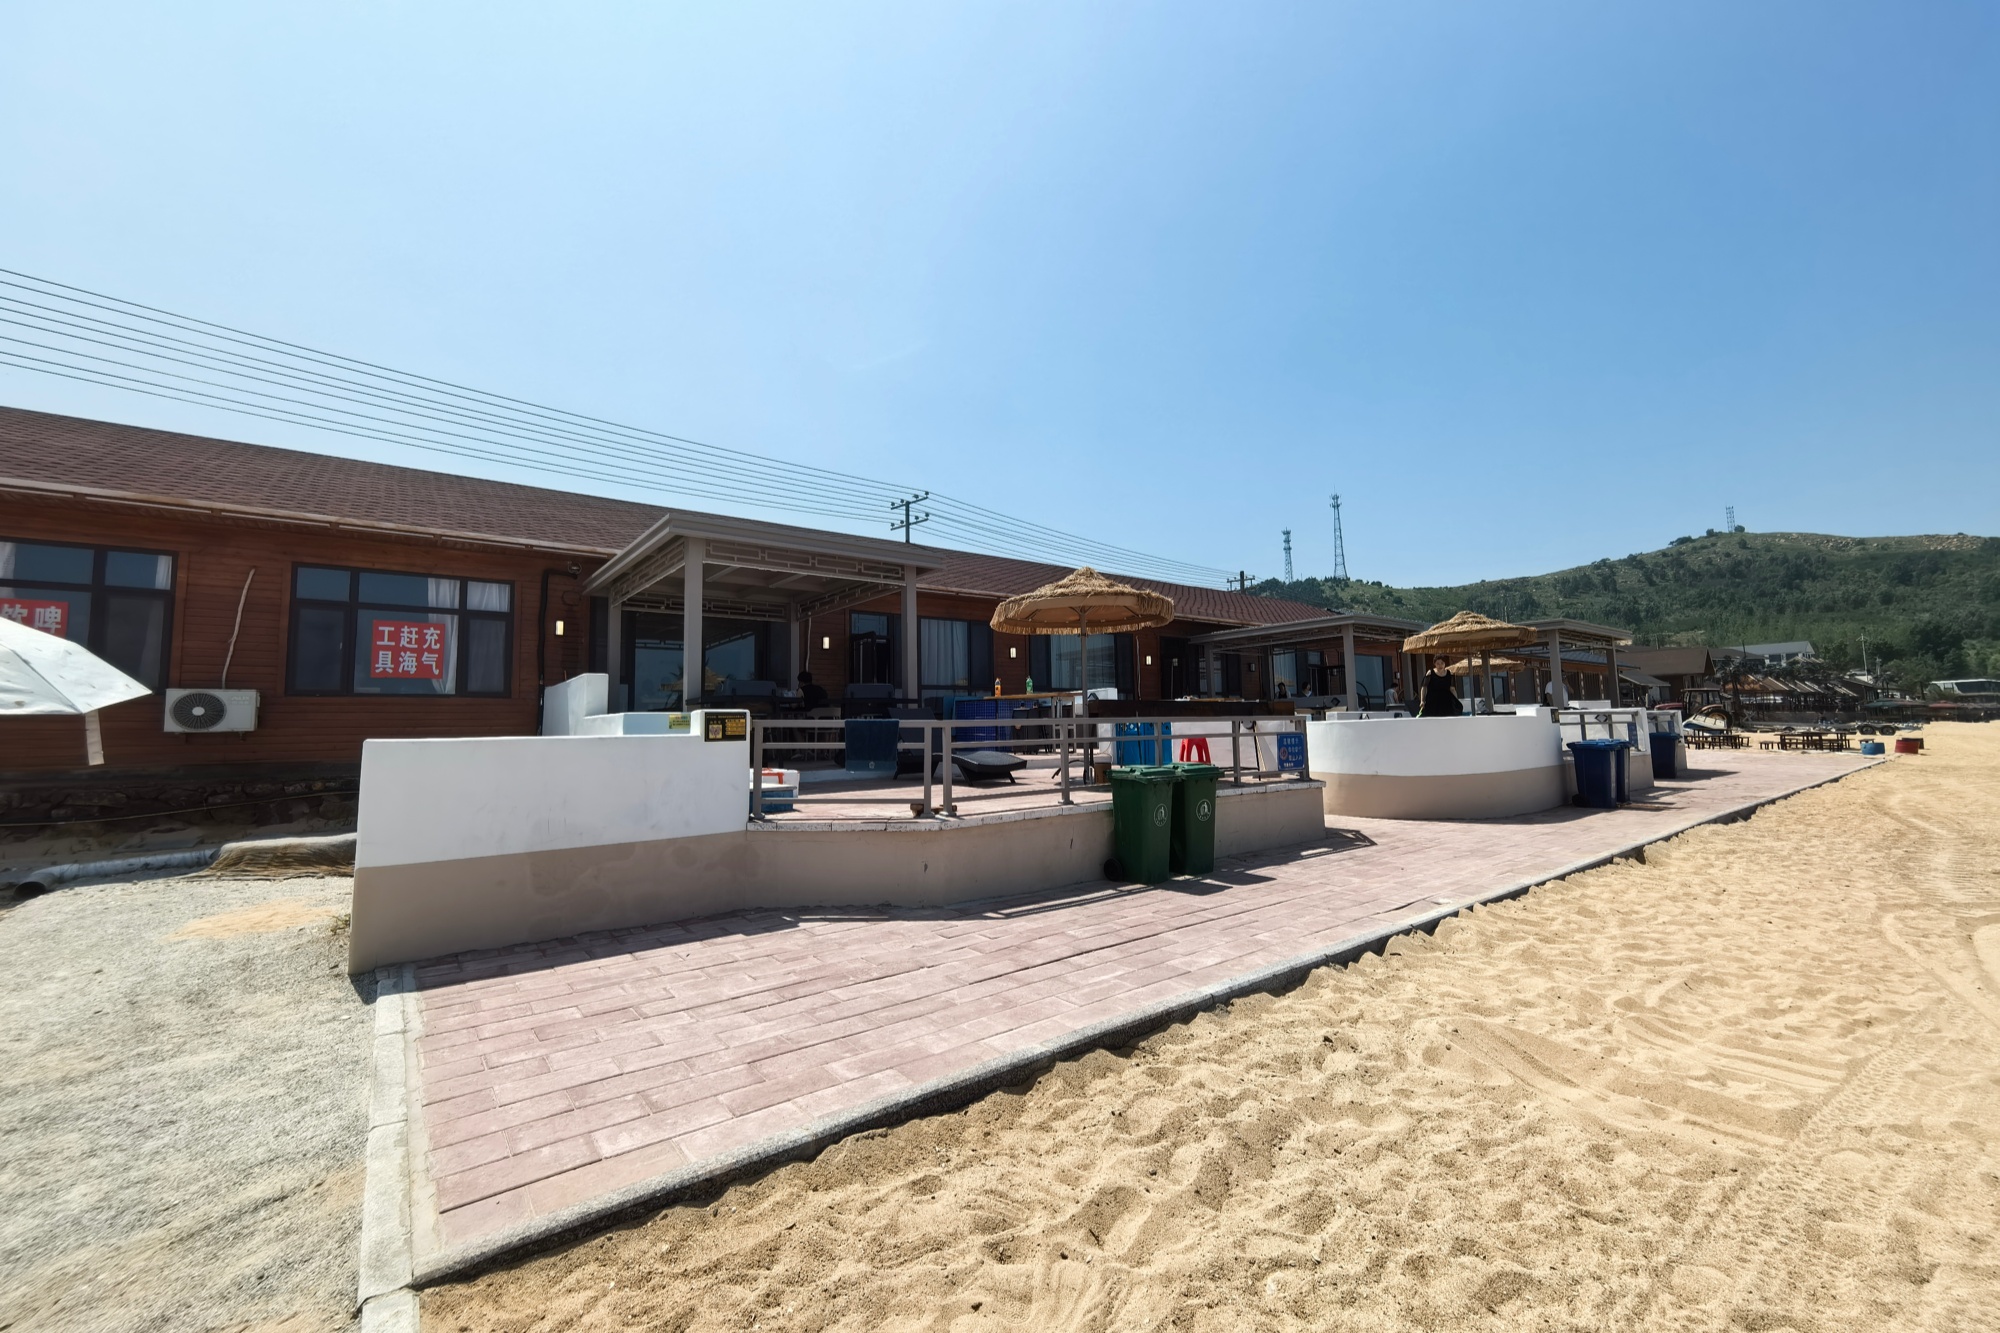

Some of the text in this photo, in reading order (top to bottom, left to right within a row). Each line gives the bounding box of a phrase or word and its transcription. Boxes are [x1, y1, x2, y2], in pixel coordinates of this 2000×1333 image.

[375, 626, 396, 674] 工具
[398, 625, 419, 675] 赶海
[421, 626, 441, 676] 充气
